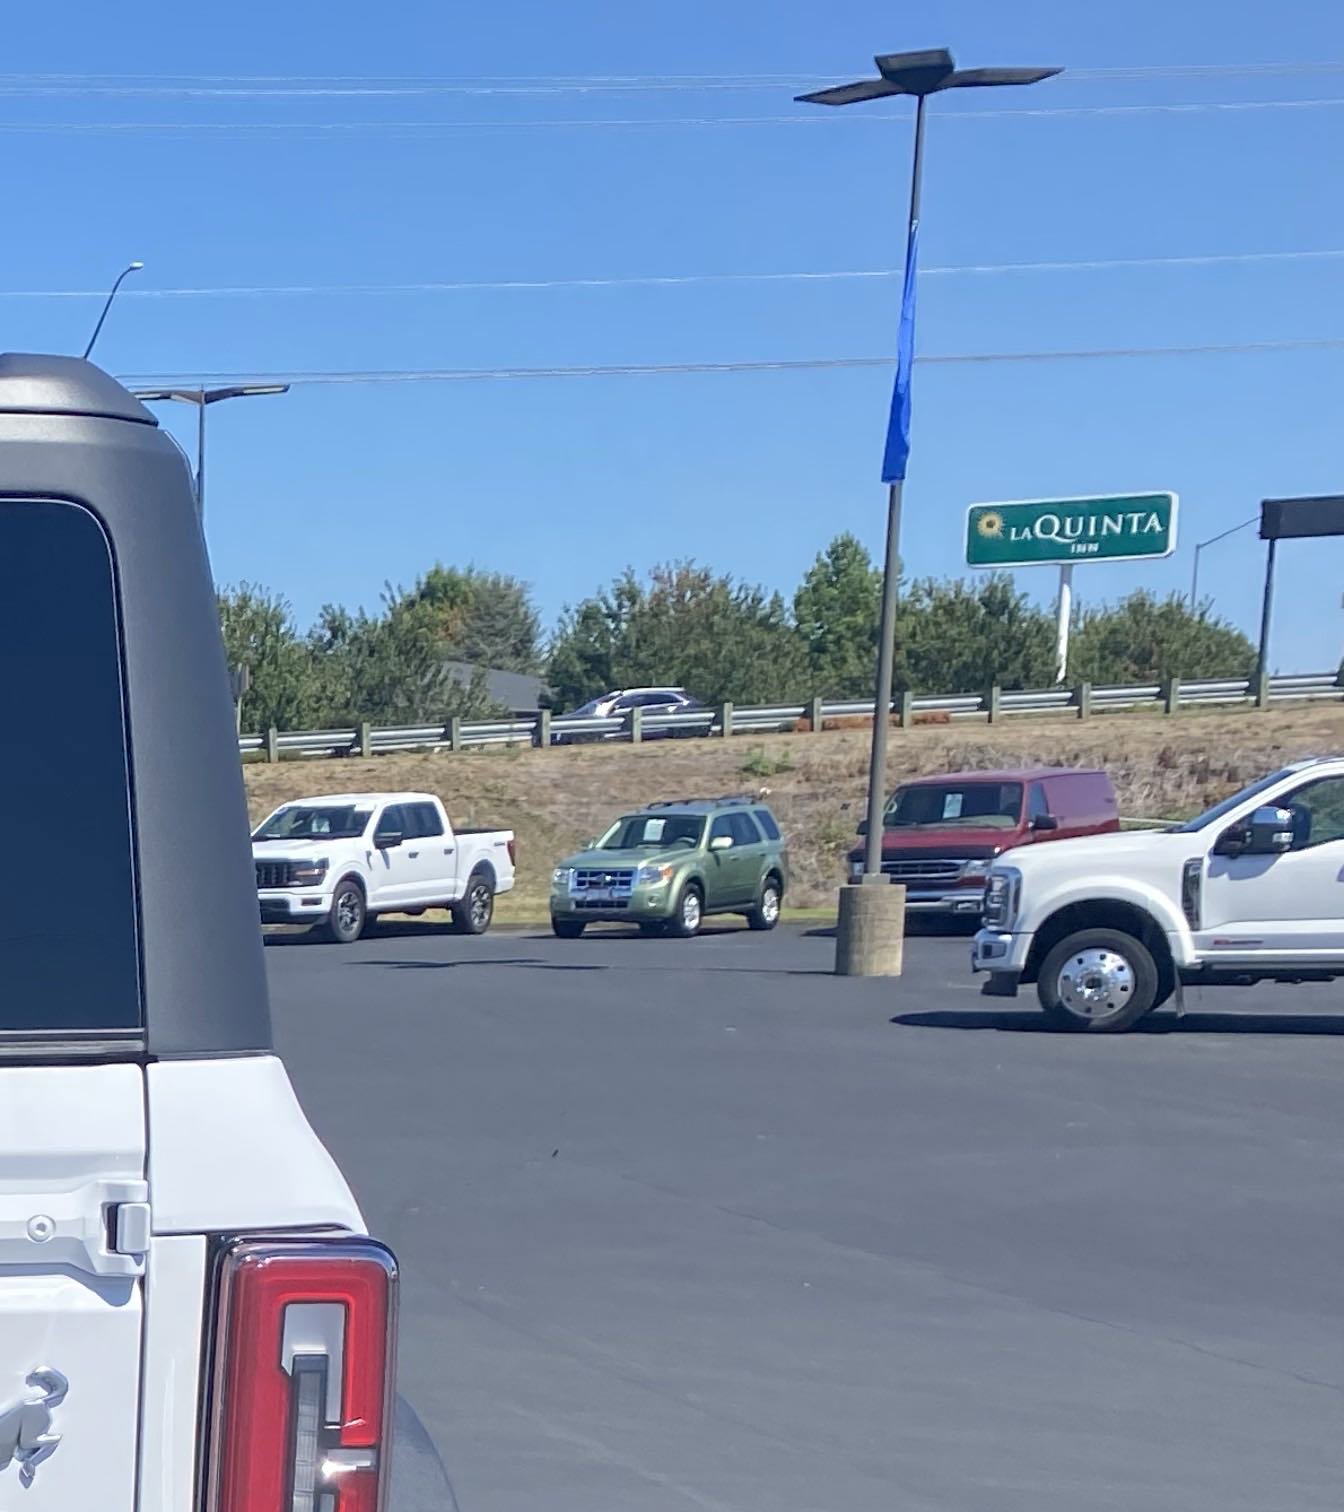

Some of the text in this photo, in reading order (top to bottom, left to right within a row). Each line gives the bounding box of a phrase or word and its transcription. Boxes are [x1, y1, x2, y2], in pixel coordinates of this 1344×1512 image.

[1010, 511, 1165, 543] LA QUINTA
[1071, 542, 1099, 554] INN
